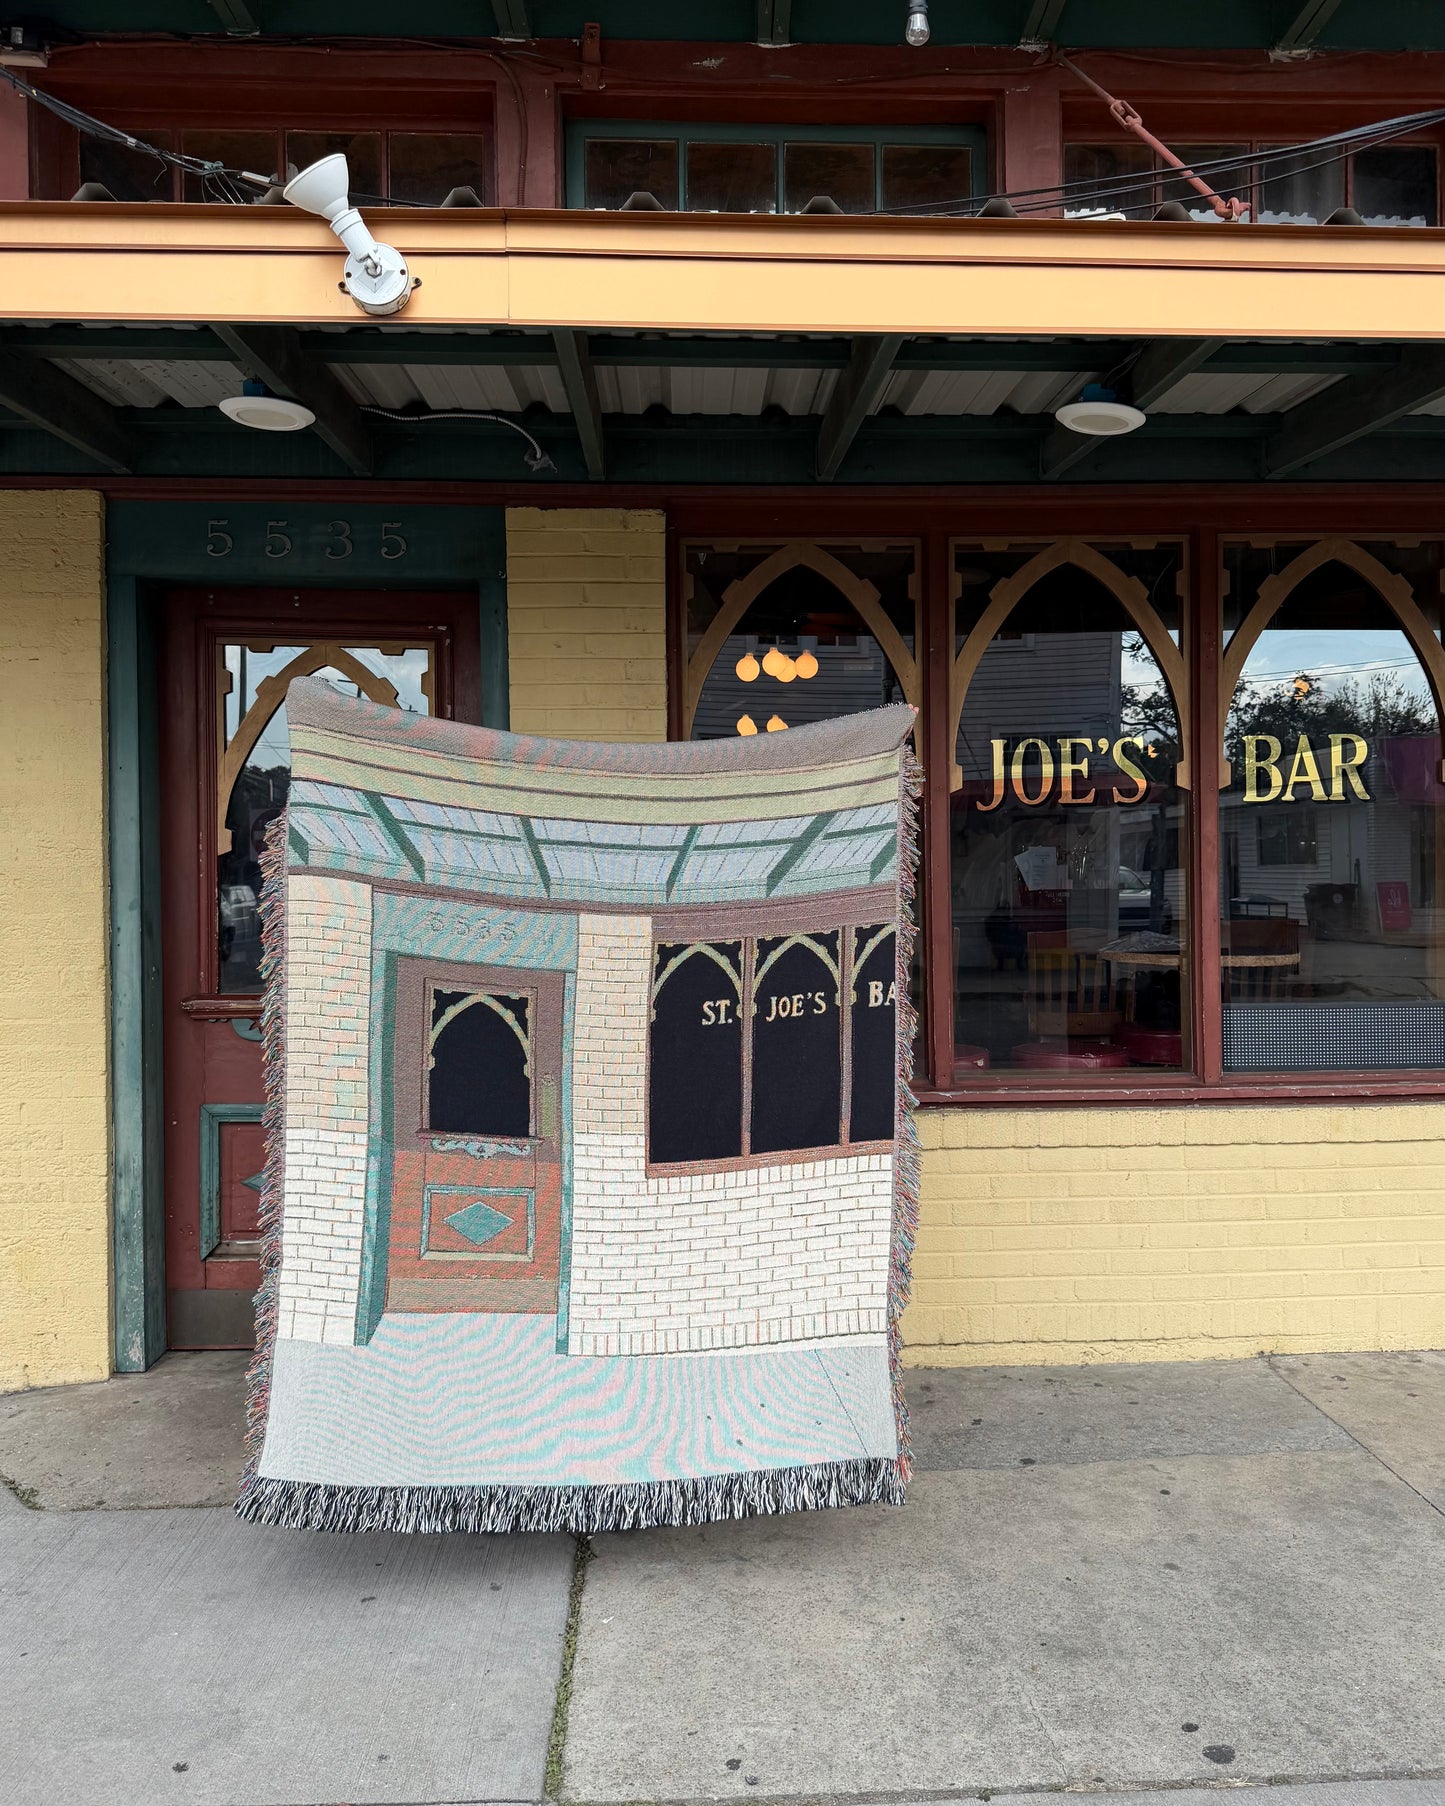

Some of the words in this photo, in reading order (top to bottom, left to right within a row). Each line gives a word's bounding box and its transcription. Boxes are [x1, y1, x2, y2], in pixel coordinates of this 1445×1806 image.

[975, 736, 1148, 812] JOE'S
[1241, 733, 1372, 802] BAR
[701, 999, 734, 1026] ST.
[765, 991, 828, 1023] JOE'S
